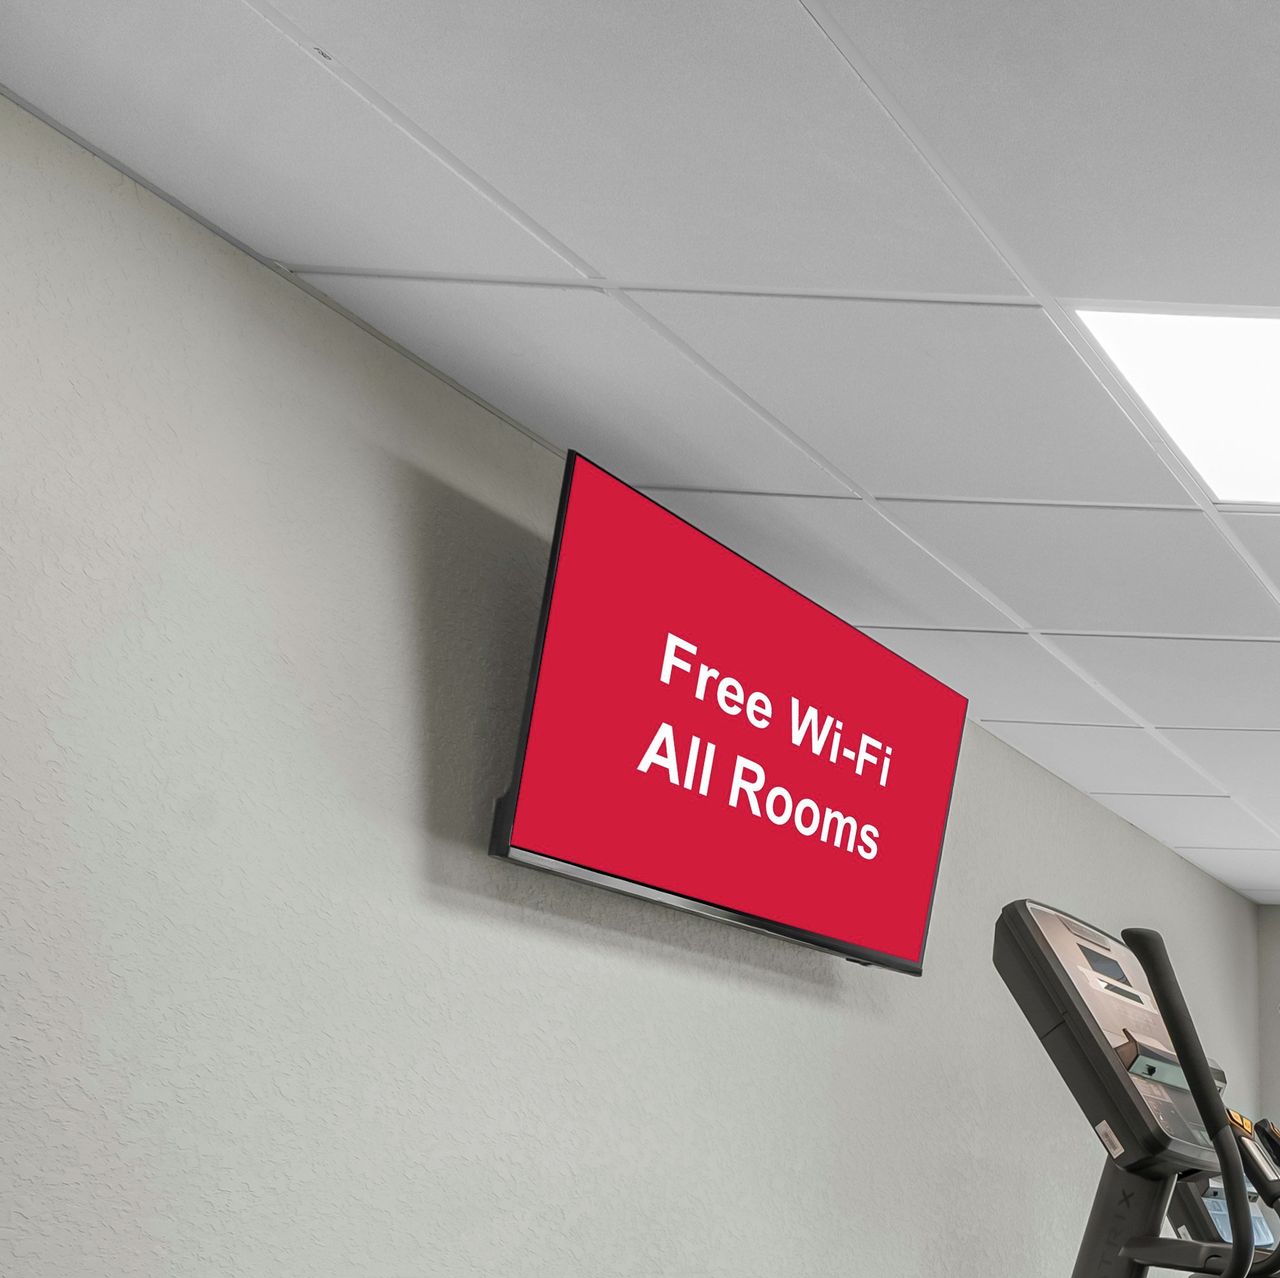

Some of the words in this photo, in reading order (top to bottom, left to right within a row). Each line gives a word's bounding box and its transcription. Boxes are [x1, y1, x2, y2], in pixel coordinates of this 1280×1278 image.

[660, 633, 772, 729] Free
[791, 697, 892, 787] Wi-Fi
[637, 723, 715, 796] All
[729, 755, 880, 859] Rooms
